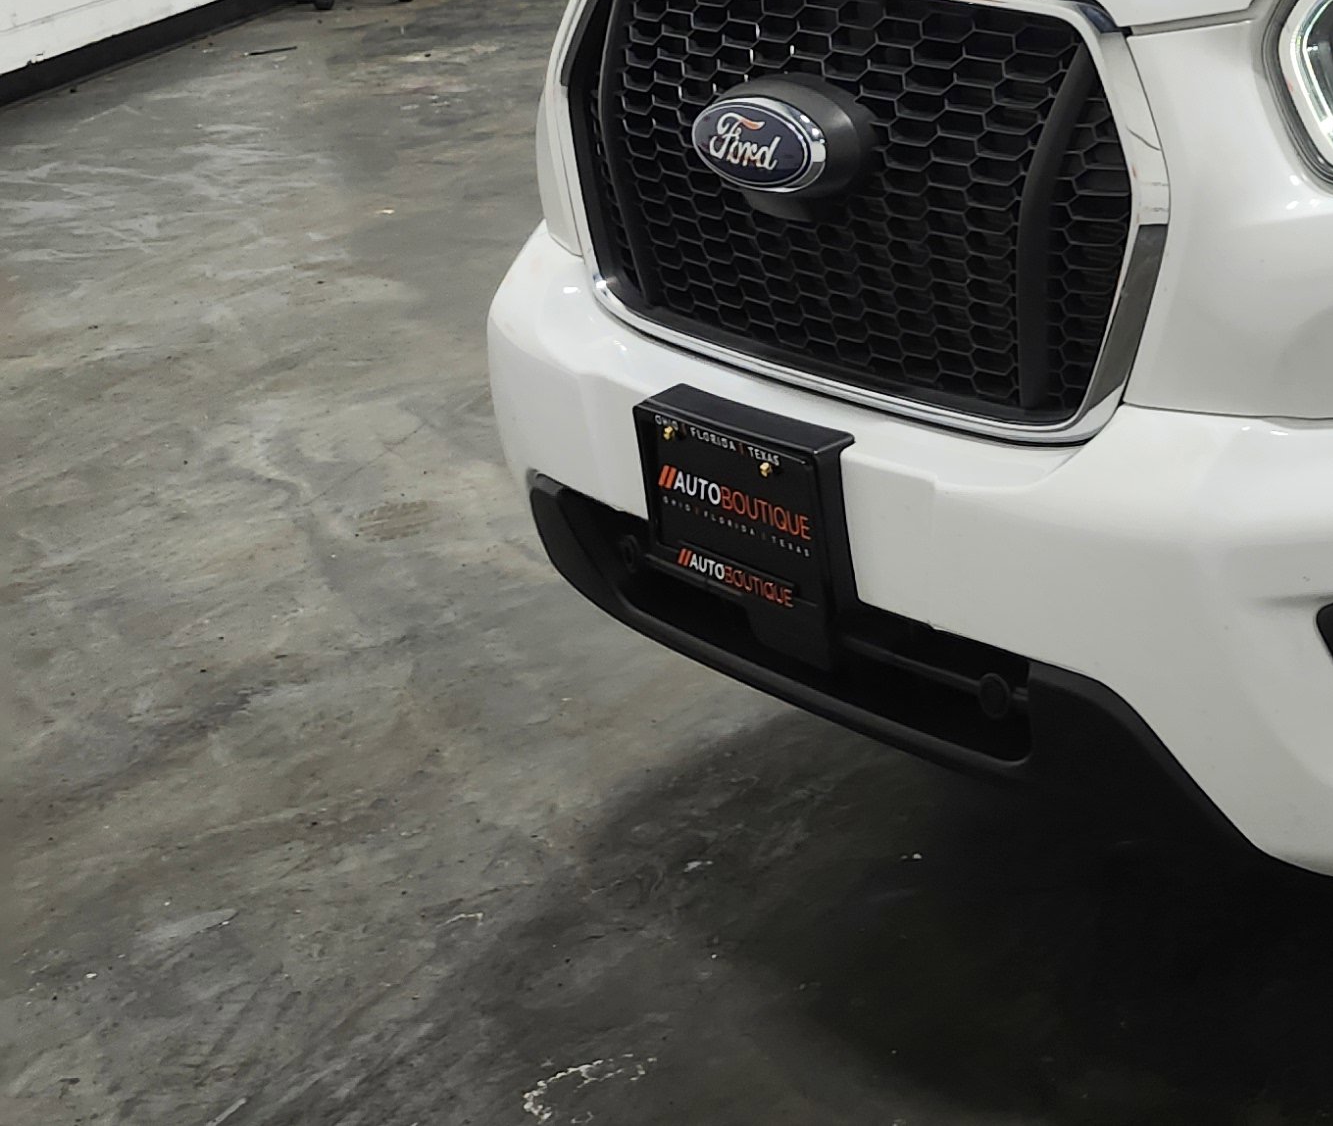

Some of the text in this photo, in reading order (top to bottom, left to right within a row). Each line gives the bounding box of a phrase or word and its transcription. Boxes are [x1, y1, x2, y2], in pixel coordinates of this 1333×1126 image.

[709, 112, 782, 171] Ford
[690, 427, 737, 451] FLORIDA
[747, 446, 780, 466] TEXAS
